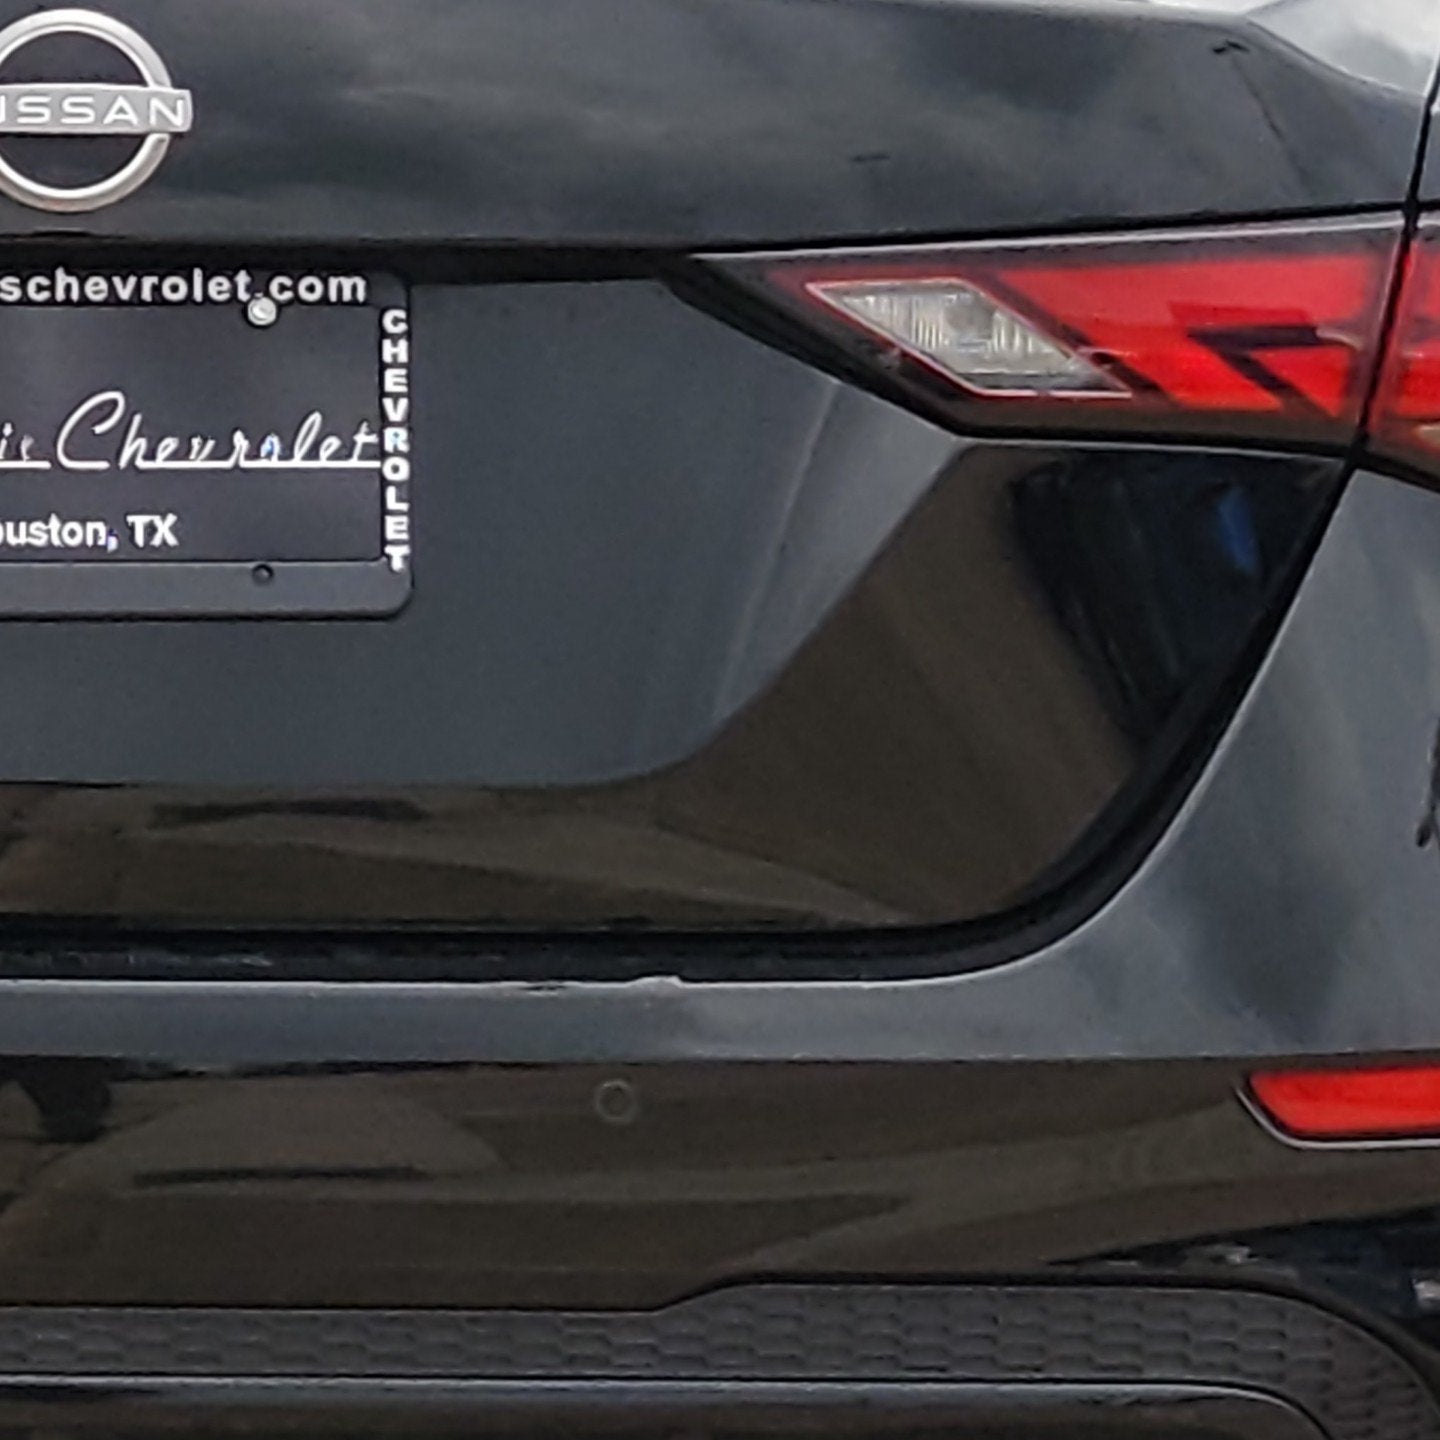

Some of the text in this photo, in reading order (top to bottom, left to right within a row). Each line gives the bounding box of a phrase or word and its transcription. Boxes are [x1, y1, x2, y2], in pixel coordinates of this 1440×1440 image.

[56, 390, 382, 469] Chevrolet
[382, 308, 411, 571] CHEVROLET
[126, 514, 179, 547] TX
